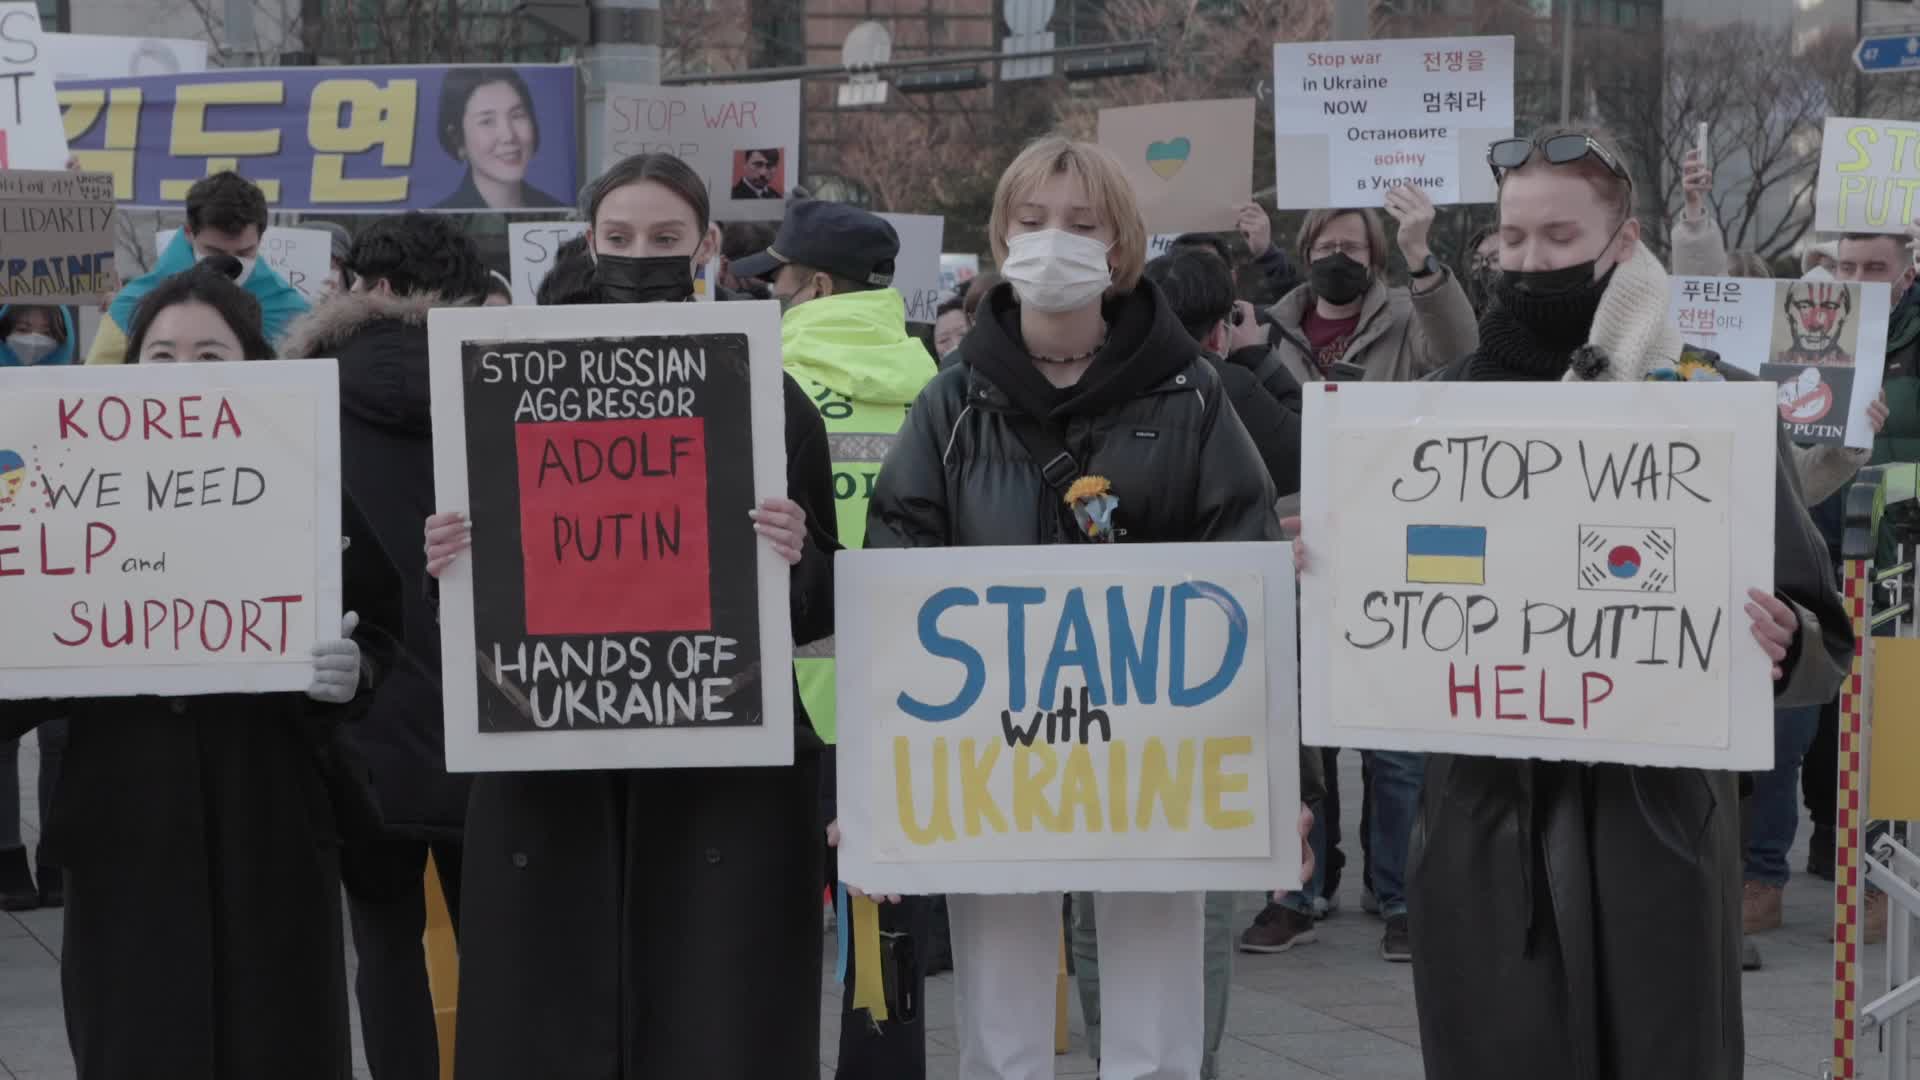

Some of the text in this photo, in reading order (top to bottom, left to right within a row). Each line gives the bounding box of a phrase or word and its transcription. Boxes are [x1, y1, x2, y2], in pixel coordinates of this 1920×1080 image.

[1307, 52, 1383, 68] Stop war
[1423, 50, 1487, 73] 전쟁을
[1303, 74, 1388, 92] in Ukraine
[1423, 90, 1487, 114] 멈춰라
[612, 97, 759, 137] STOP WAR
[1323, 99, 1368, 116] NOW
[1346, 126, 1448, 142] Остановите
[1836, 125, 1920, 174] ST
[1373, 151, 1427, 168] войну
[1357, 180, 1367, 190] в
[1682, 280, 1742, 303] 푸틴은
[482, 347, 708, 388] STOP RUSSIAN
[58, 395, 242, 442] KOREA
[514, 387, 697, 423] AGGRESSOR
[1793, 423, 1844, 438] PUTIN
[537, 431, 697, 489] ADOLF
[1391, 435, 1713, 503] STOP WAR
[40, 466, 266, 511] WE NEED
[552, 504, 681, 563] PUTIN
[121, 551, 166, 574] and
[53, 594, 303, 656] SUPPORT
[1345, 590, 1722, 673] STOP PUTIN
[494, 635, 739, 684] HANDS OFF
[896, 580, 1249, 723] STAND
[529, 676, 734, 729] UKRAINE
[1000, 685, 1112, 748] with
[1448, 661, 1615, 731] HELP
[893, 734, 1256, 847] UKRAINE
